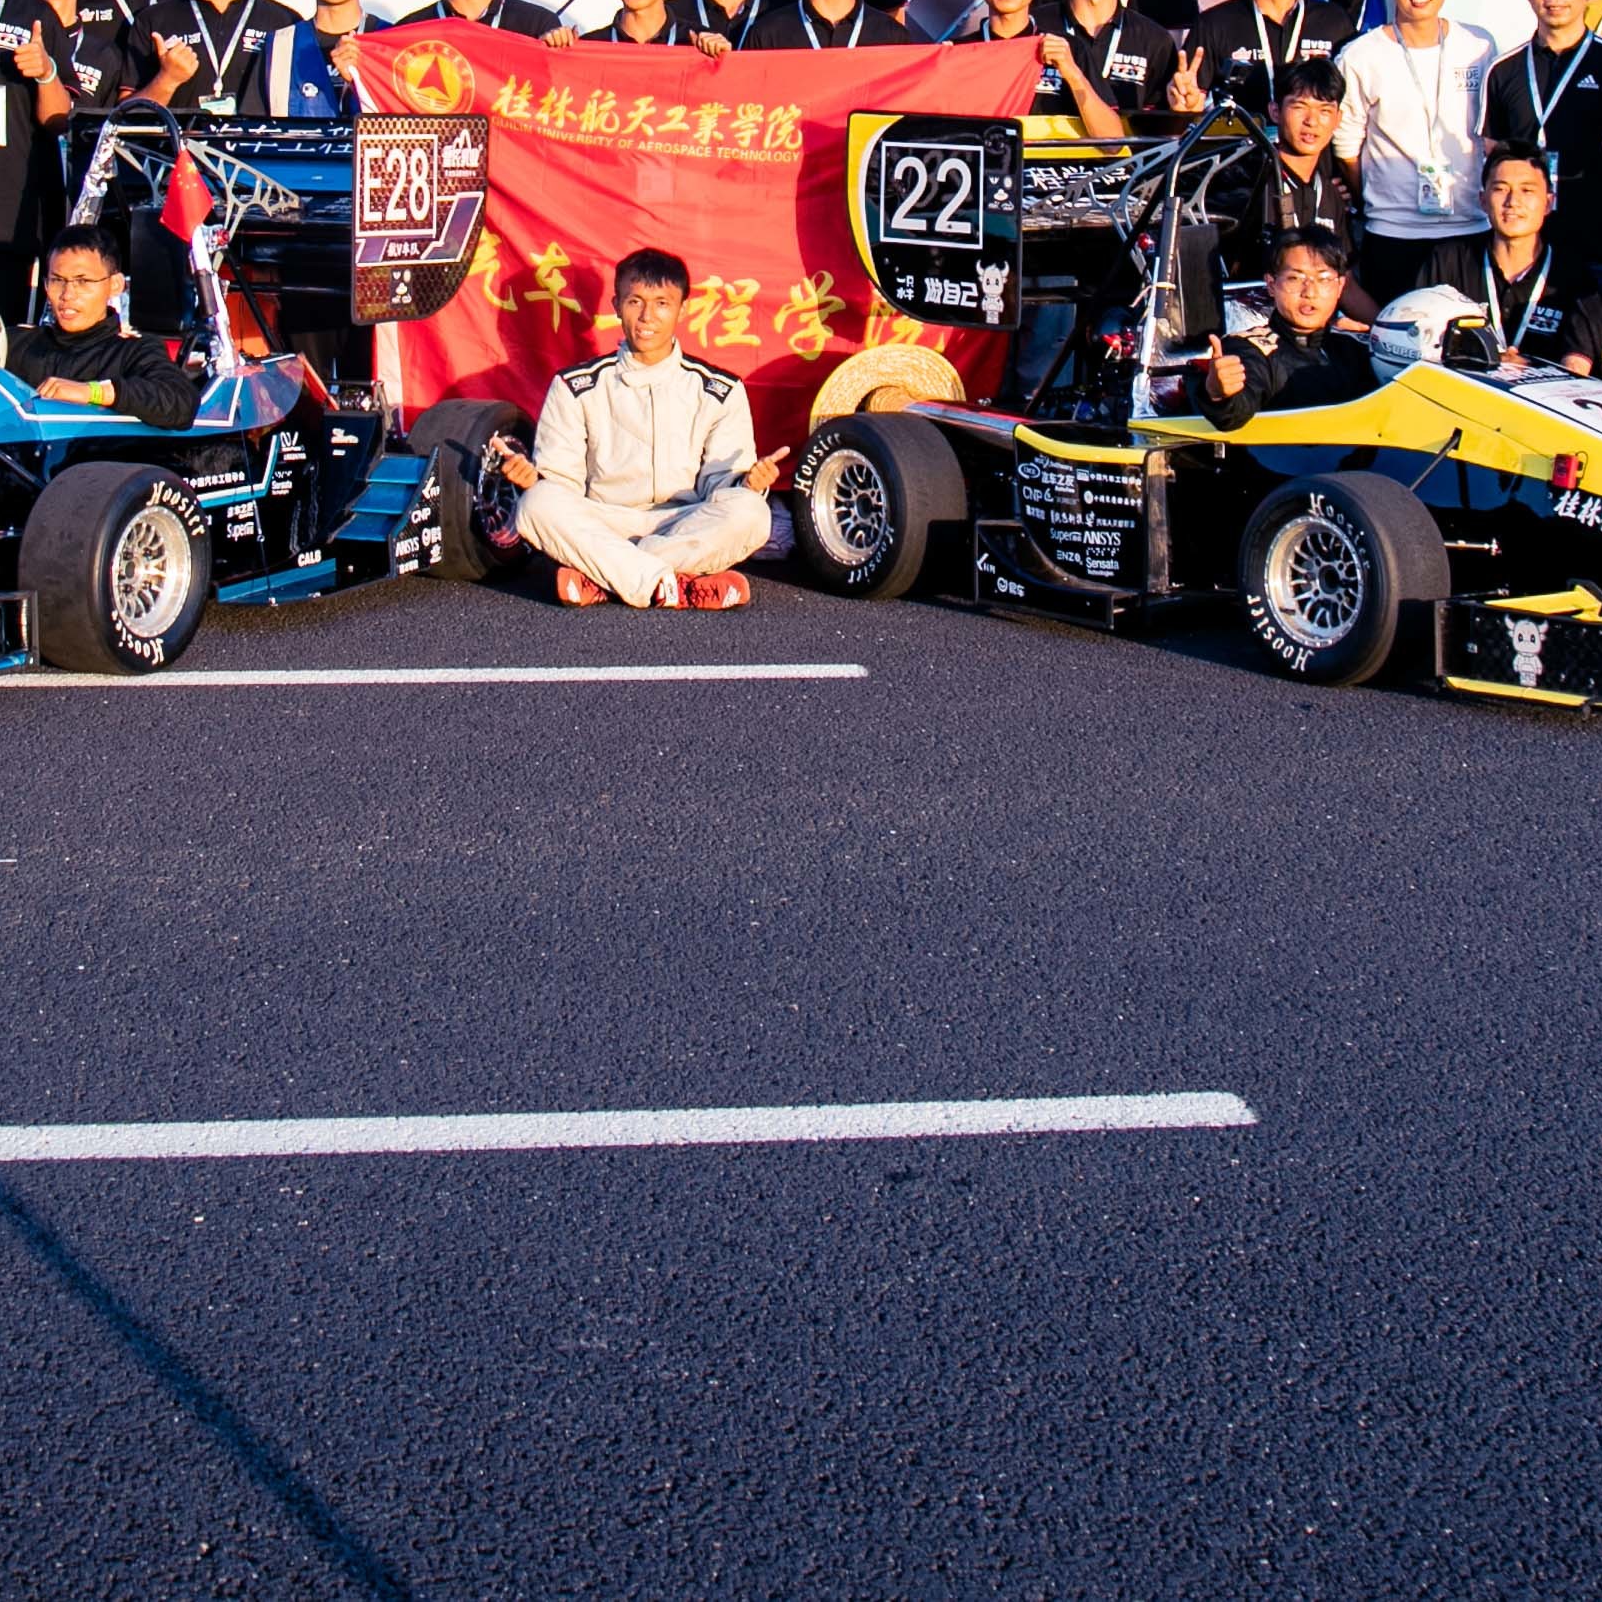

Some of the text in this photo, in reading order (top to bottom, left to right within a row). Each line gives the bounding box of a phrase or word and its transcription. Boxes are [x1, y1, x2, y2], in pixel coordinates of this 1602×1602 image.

[618, 138, 634, 149] OF
[637, 140, 711, 159] AEROSPACE
[716, 147, 800, 162] TECHNOLOGY
[363, 147, 430, 222] E28
[891, 156, 972, 234] 22
[794, 432, 841, 498] Hoosier
[146, 480, 206, 537] Hoosier
[1083, 530, 1122, 546] ANSYS
[111, 609, 165, 667] Hoosier
[1247, 594, 1315, 672] Hoosier
